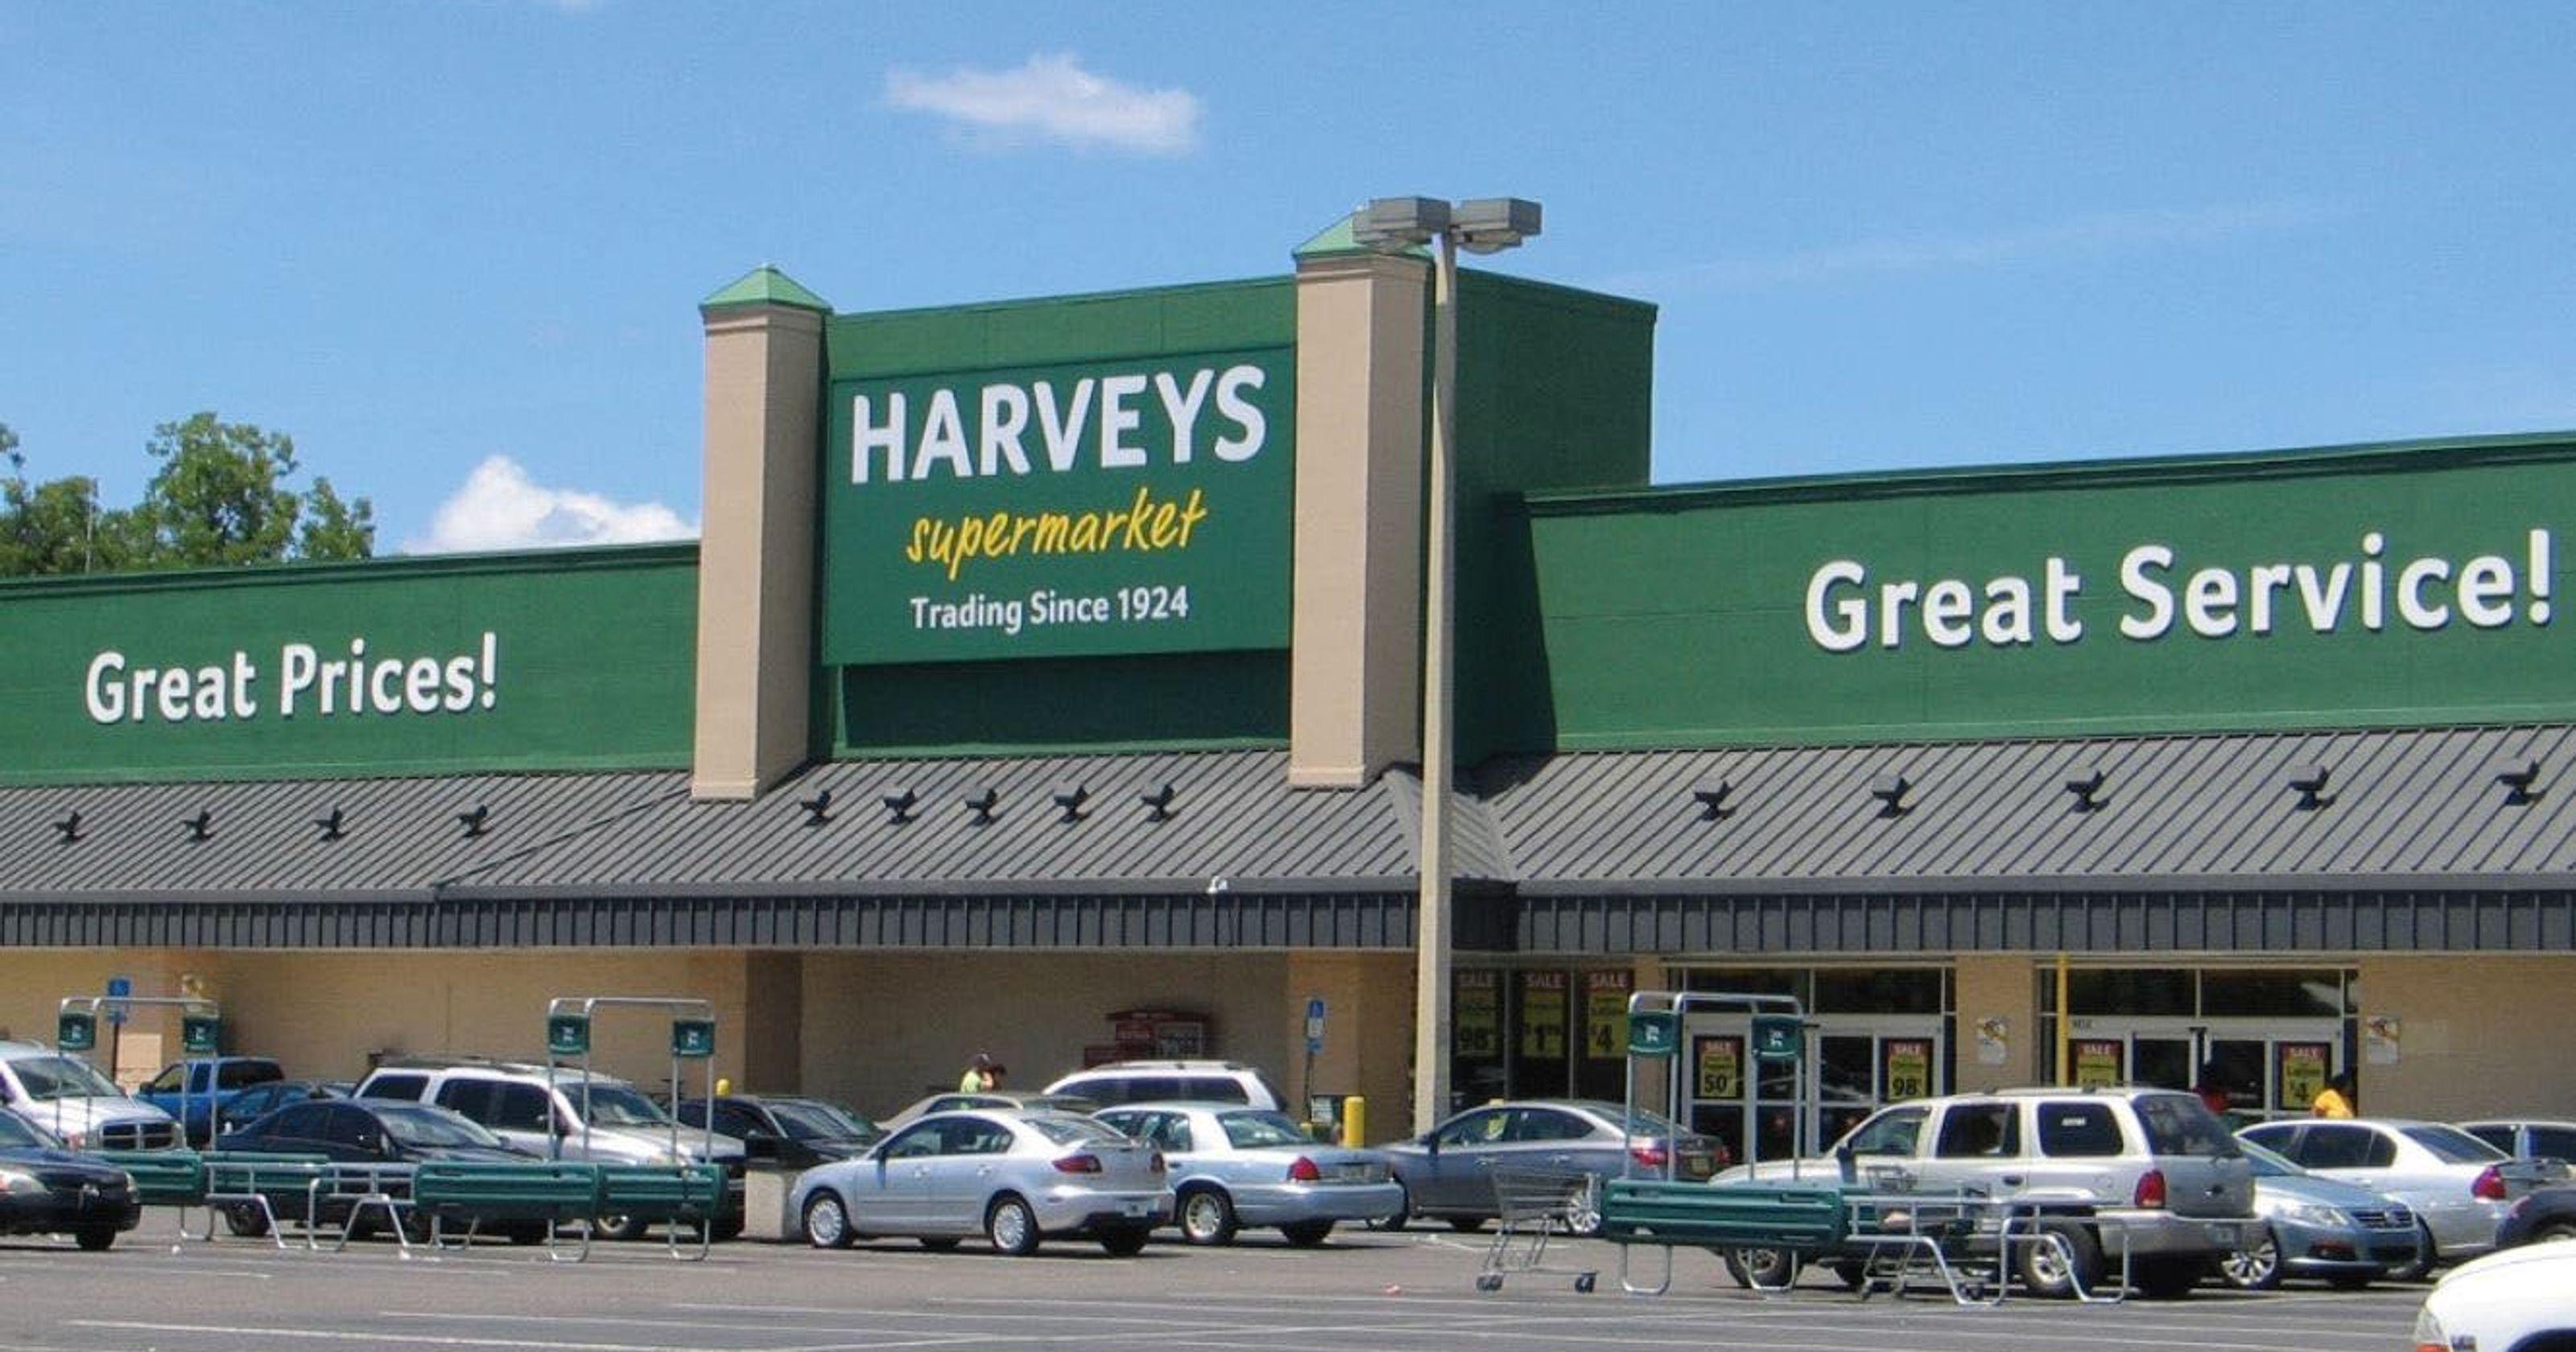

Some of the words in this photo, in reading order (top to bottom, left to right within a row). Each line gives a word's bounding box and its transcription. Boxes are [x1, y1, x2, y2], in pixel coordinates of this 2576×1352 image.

[852, 365, 1267, 484] HARVEYS
[906, 487, 1208, 581] supermarket
[910, 594, 1022, 636] Trading
[1029, 589, 1109, 624] Since
[1117, 585, 1188, 620] 1924
[1805, 558, 2083, 650] Great
[2120, 528, 2551, 639] Service!
[86, 651, 258, 724] Great
[280, 631, 497, 715] Prices!
[1527, 973, 1565, 987] SALE
[1589, 972, 1628, 987] SALE
